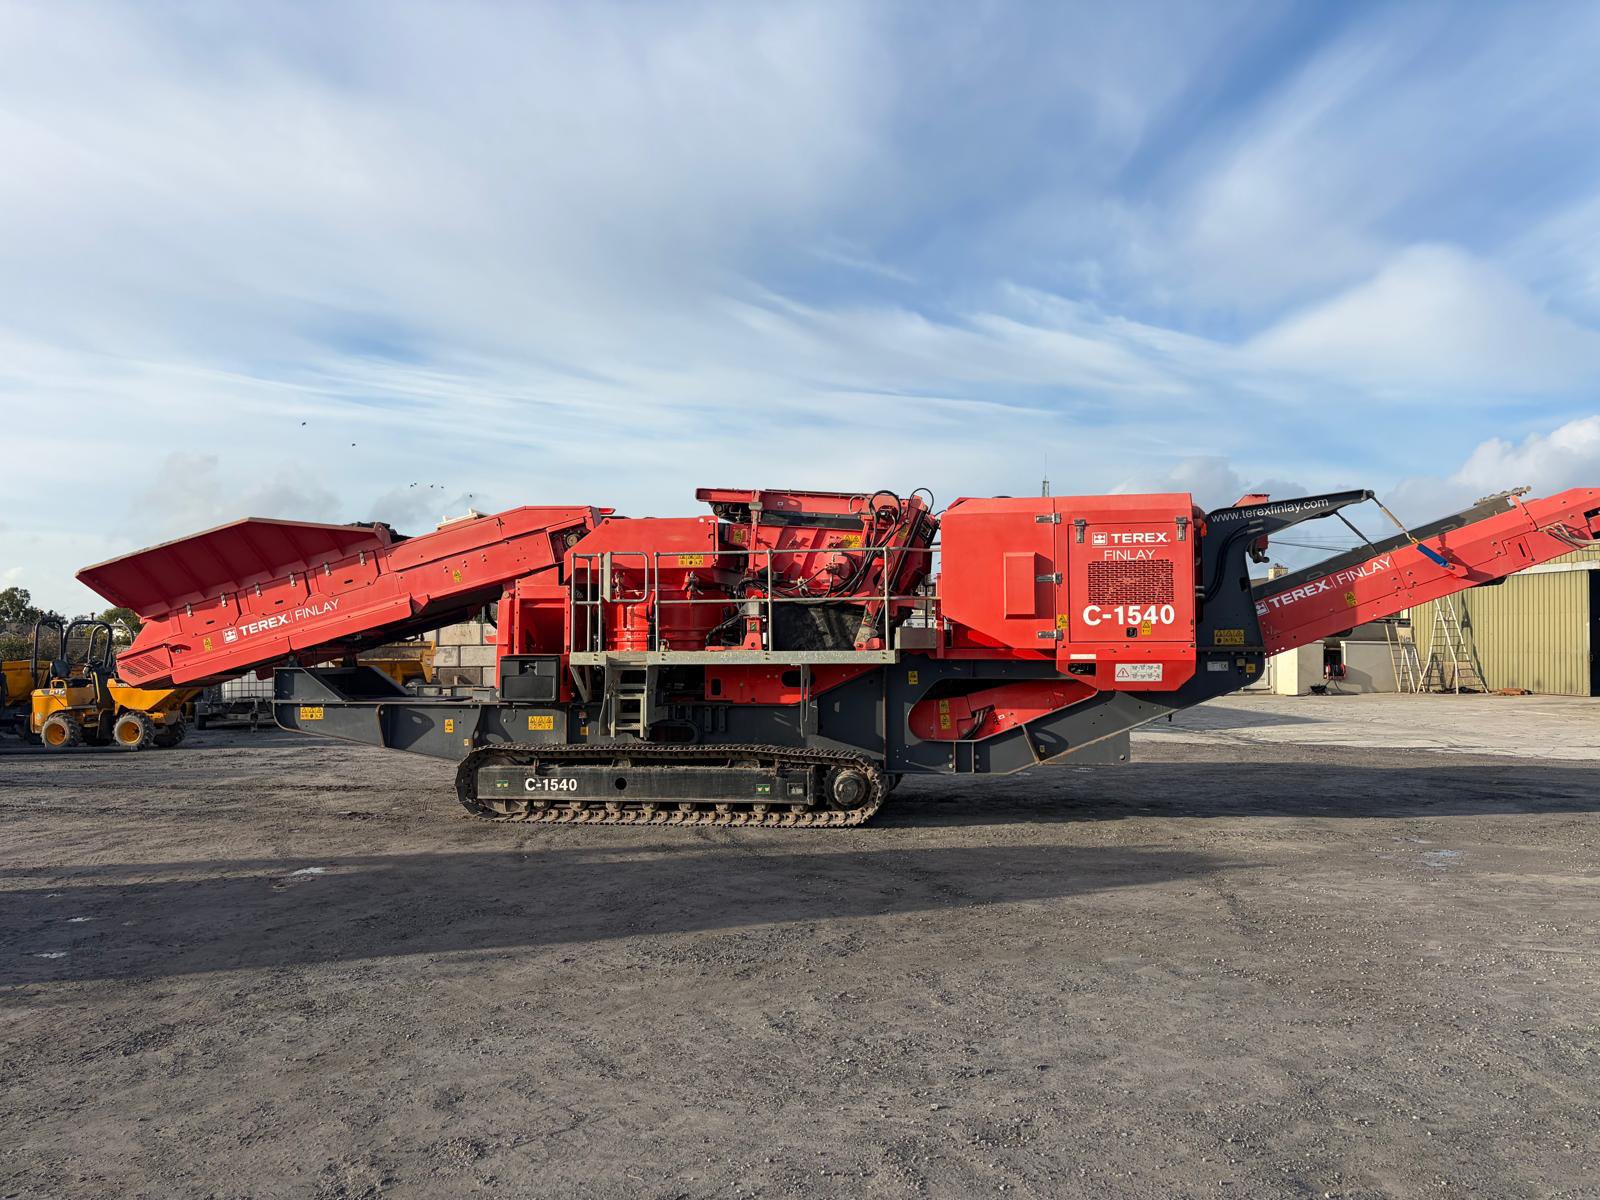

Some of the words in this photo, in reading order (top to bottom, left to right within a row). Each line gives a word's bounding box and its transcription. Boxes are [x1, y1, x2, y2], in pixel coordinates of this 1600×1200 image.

[1211, 498, 1329, 522] www.terexfinlay.com
[1111, 532, 1168, 544] TEREX
[1104, 549, 1156, 561] FINLAY
[1269, 580, 1330, 608] TEREX
[1336, 556, 1391, 585] FINLAY
[239, 613, 288, 636] TEREX
[295, 599, 339, 621] FINLAY
[1083, 605, 1175, 626] C-1540
[525, 778, 577, 791] C-1540
